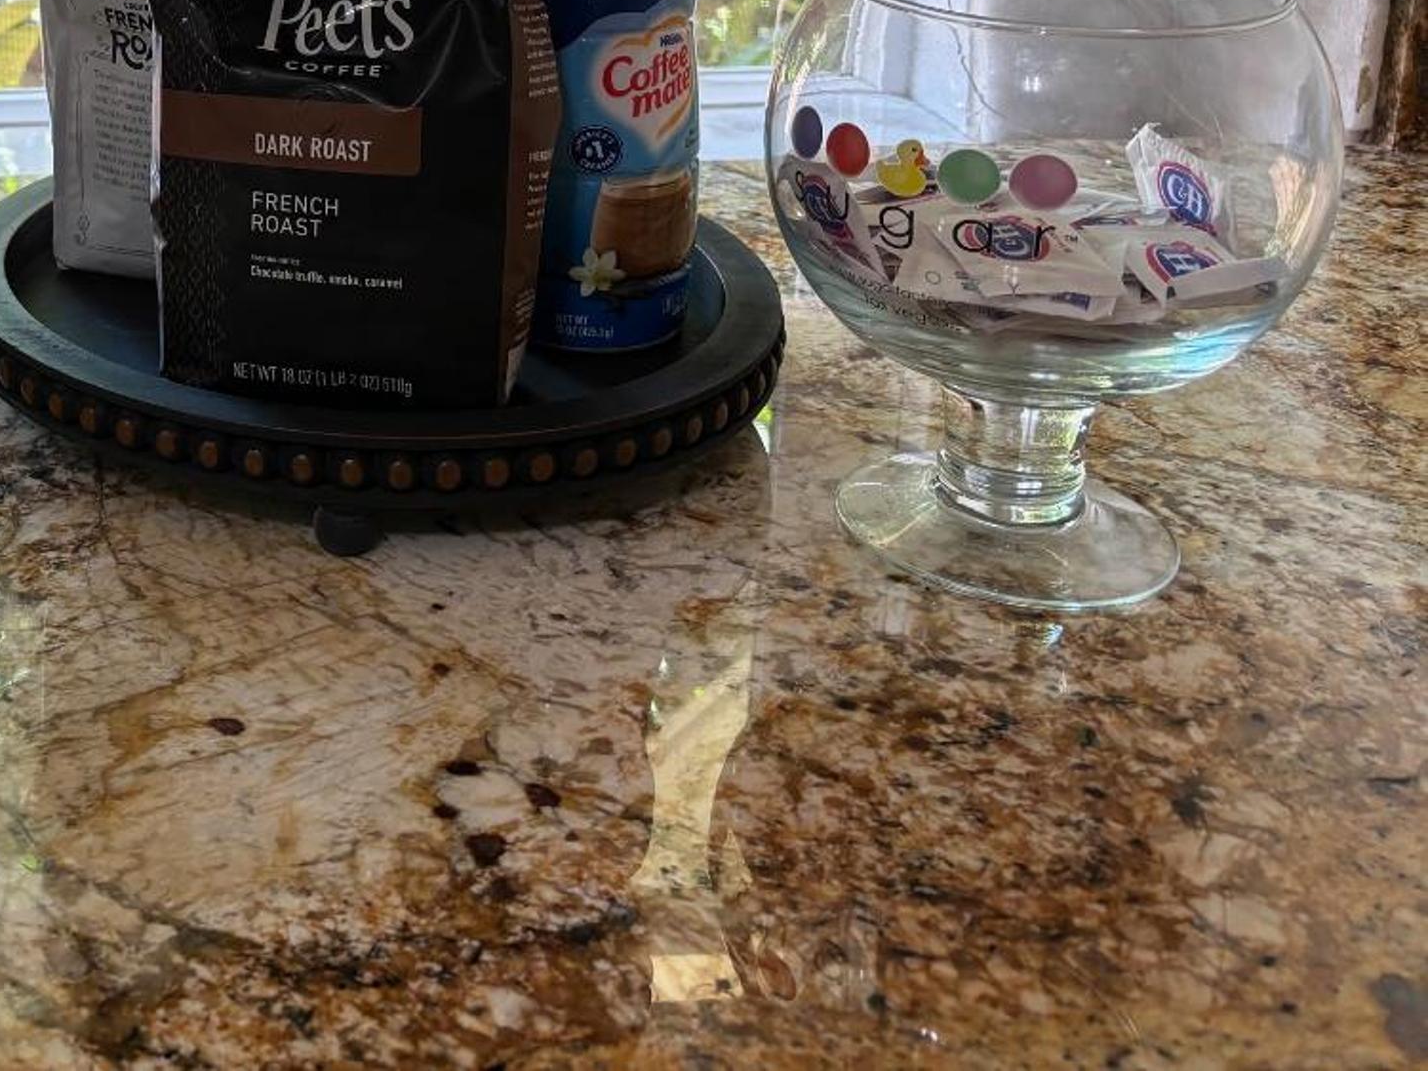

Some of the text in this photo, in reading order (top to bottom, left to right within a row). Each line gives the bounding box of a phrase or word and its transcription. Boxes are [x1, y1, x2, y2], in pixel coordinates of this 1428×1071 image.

[104, 8, 152, 31] FREN
[284, 60, 382, 78] COFFEE
[602, 44, 690, 97] Coffee
[630, 67, 692, 118] mate
[254, 133, 371, 162] DARK ROAST
[251, 191, 340, 217] FRENCH
[251, 214, 322, 237] ROAST
[233, 362, 256, 380] NET
[256, 365, 278, 382] WT
[282, 367, 294, 384] 18
[330, 370, 346, 386] LB
